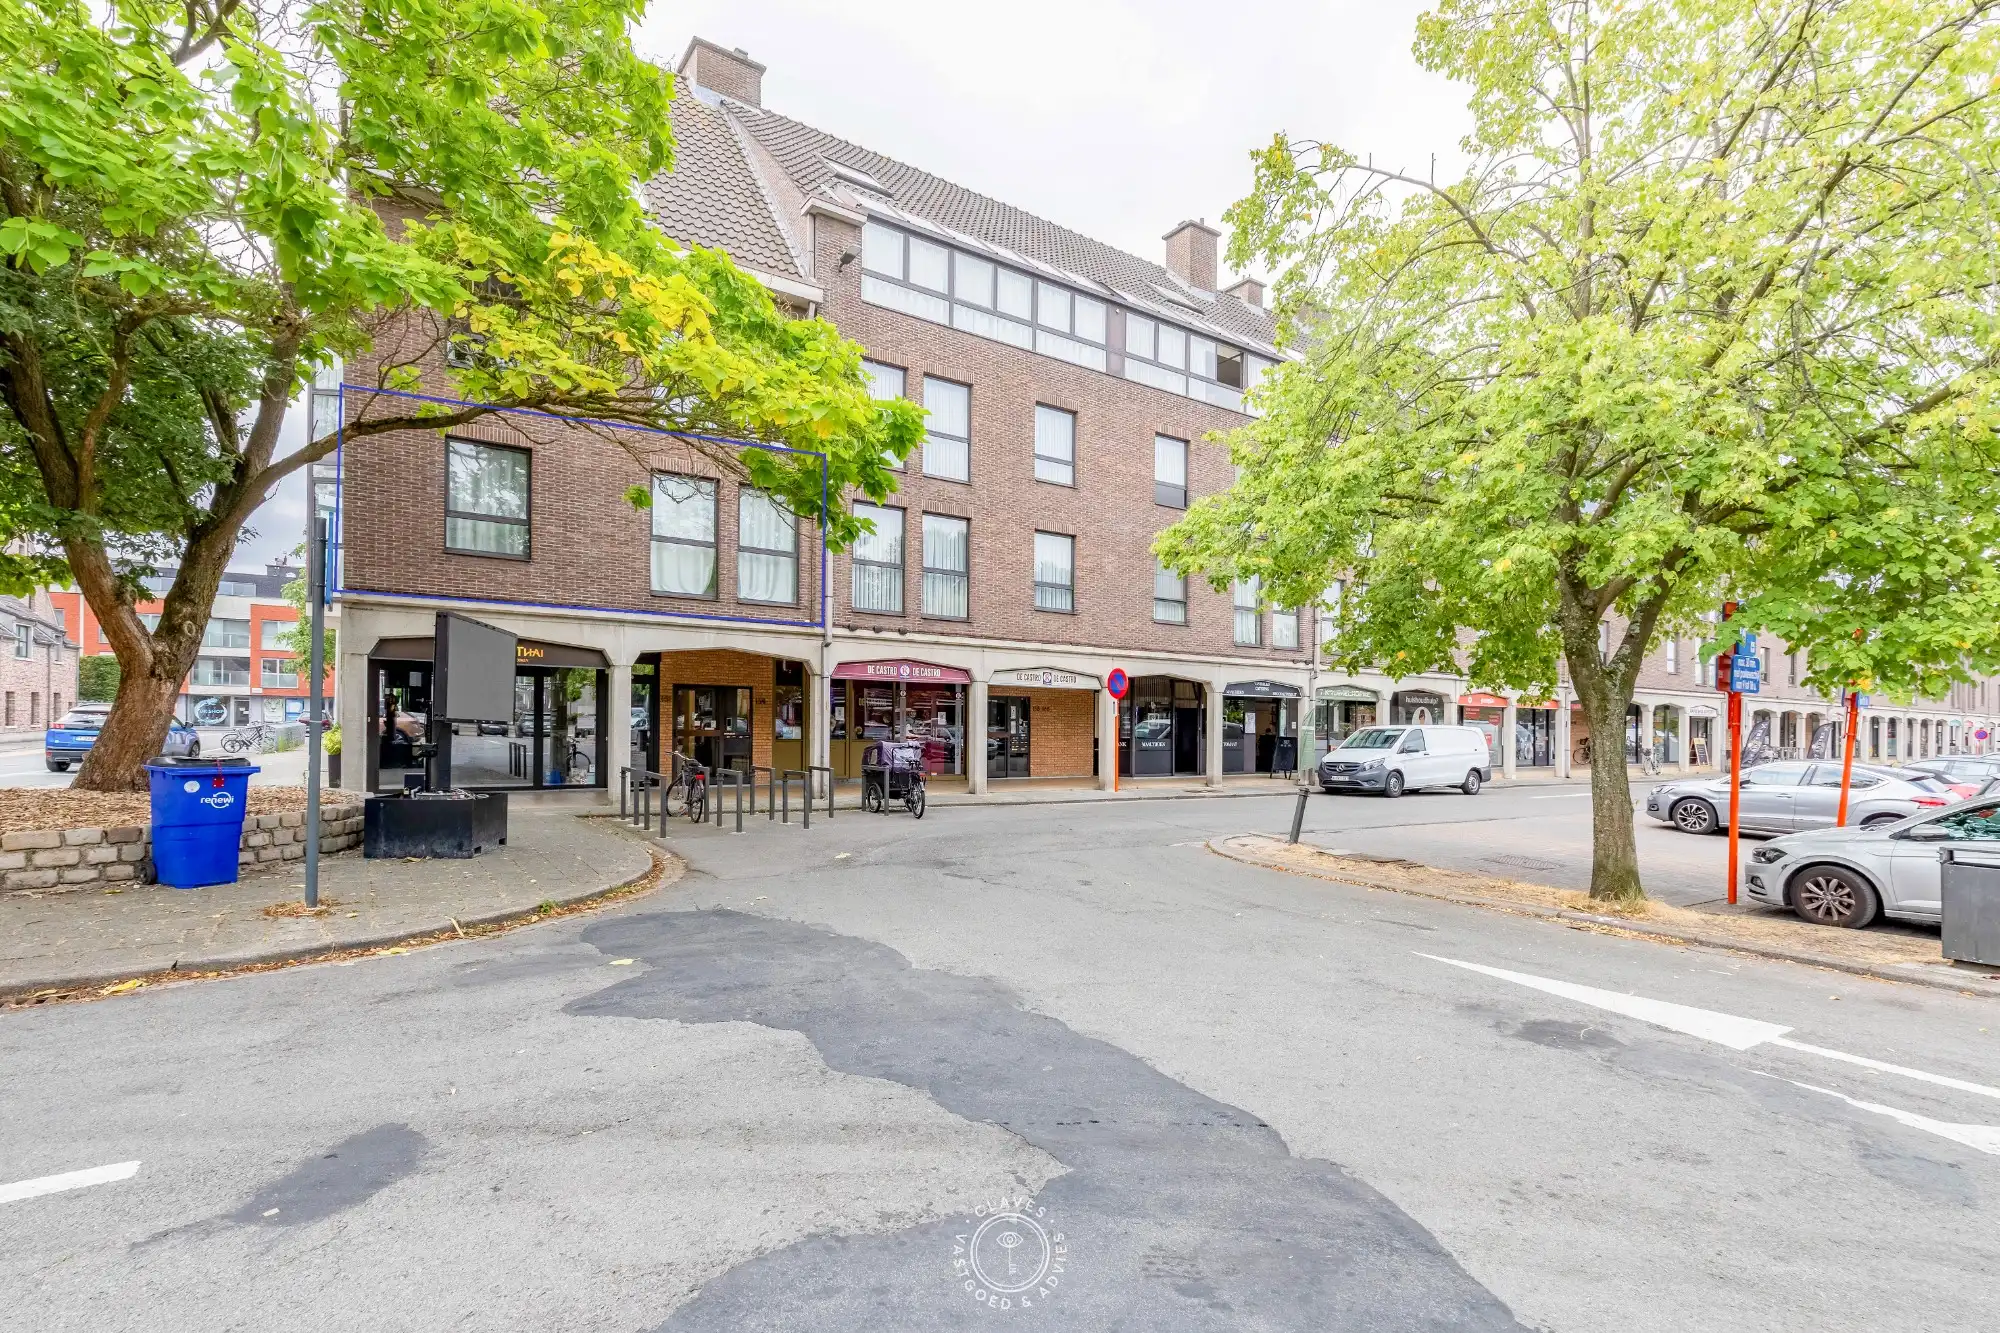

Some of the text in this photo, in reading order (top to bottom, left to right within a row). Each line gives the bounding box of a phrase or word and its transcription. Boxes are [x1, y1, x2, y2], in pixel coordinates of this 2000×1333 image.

[867, 665, 897, 676] DE CASTRO
[912, 667, 941, 678] DE CASTRO
[200, 796, 234, 804] renewi
